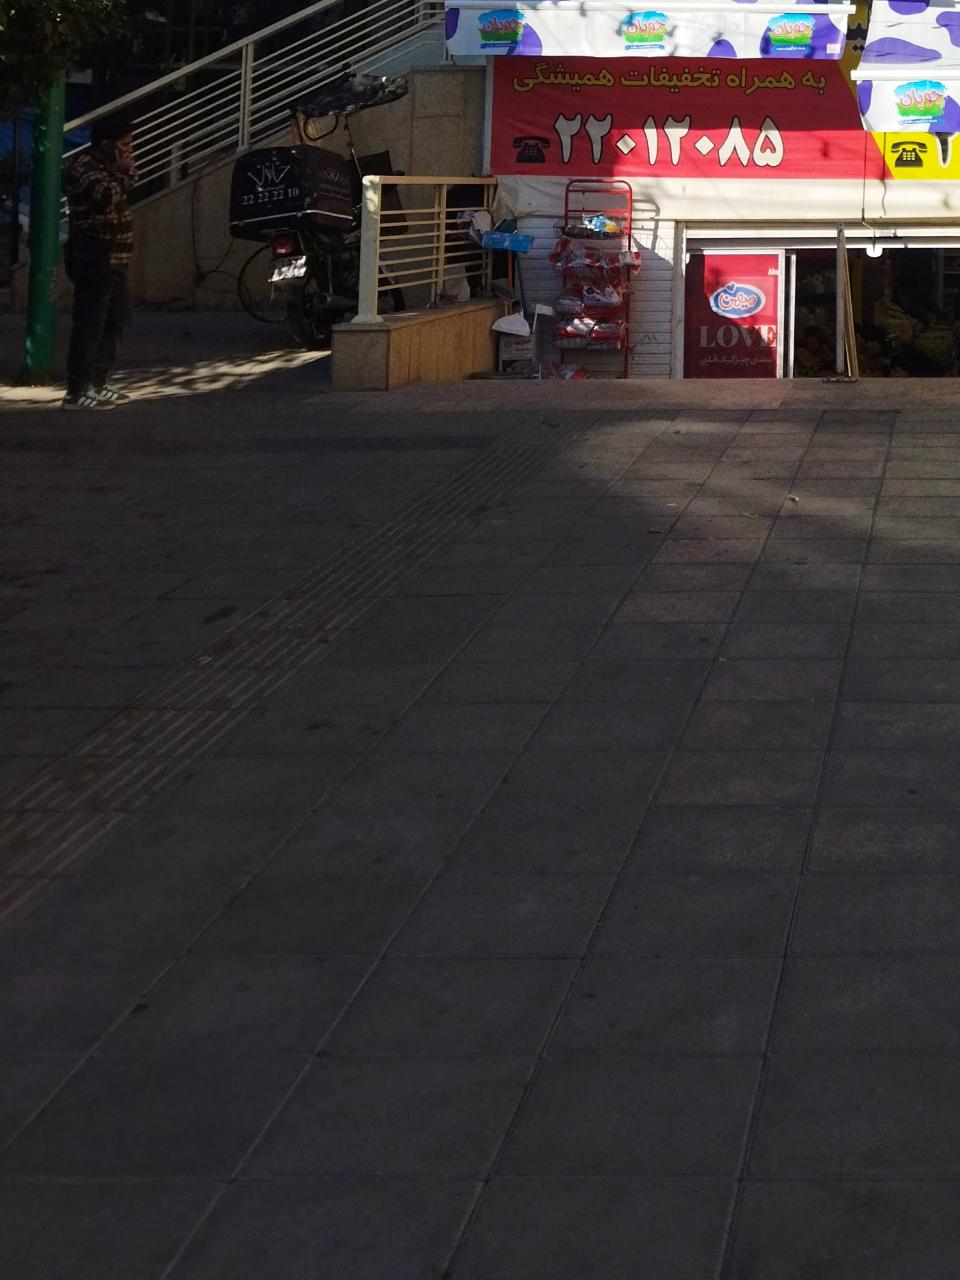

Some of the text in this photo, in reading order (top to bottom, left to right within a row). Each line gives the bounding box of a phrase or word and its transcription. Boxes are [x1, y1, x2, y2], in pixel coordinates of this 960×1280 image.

[512, 63, 827, 95] به همراه تخفیفات همیشگی
[554, 113, 784, 168] ۲۲۰۱۲۰۸۵
[718, 292, 758, 311] میهن
[699, 324, 777, 348] LOVE
